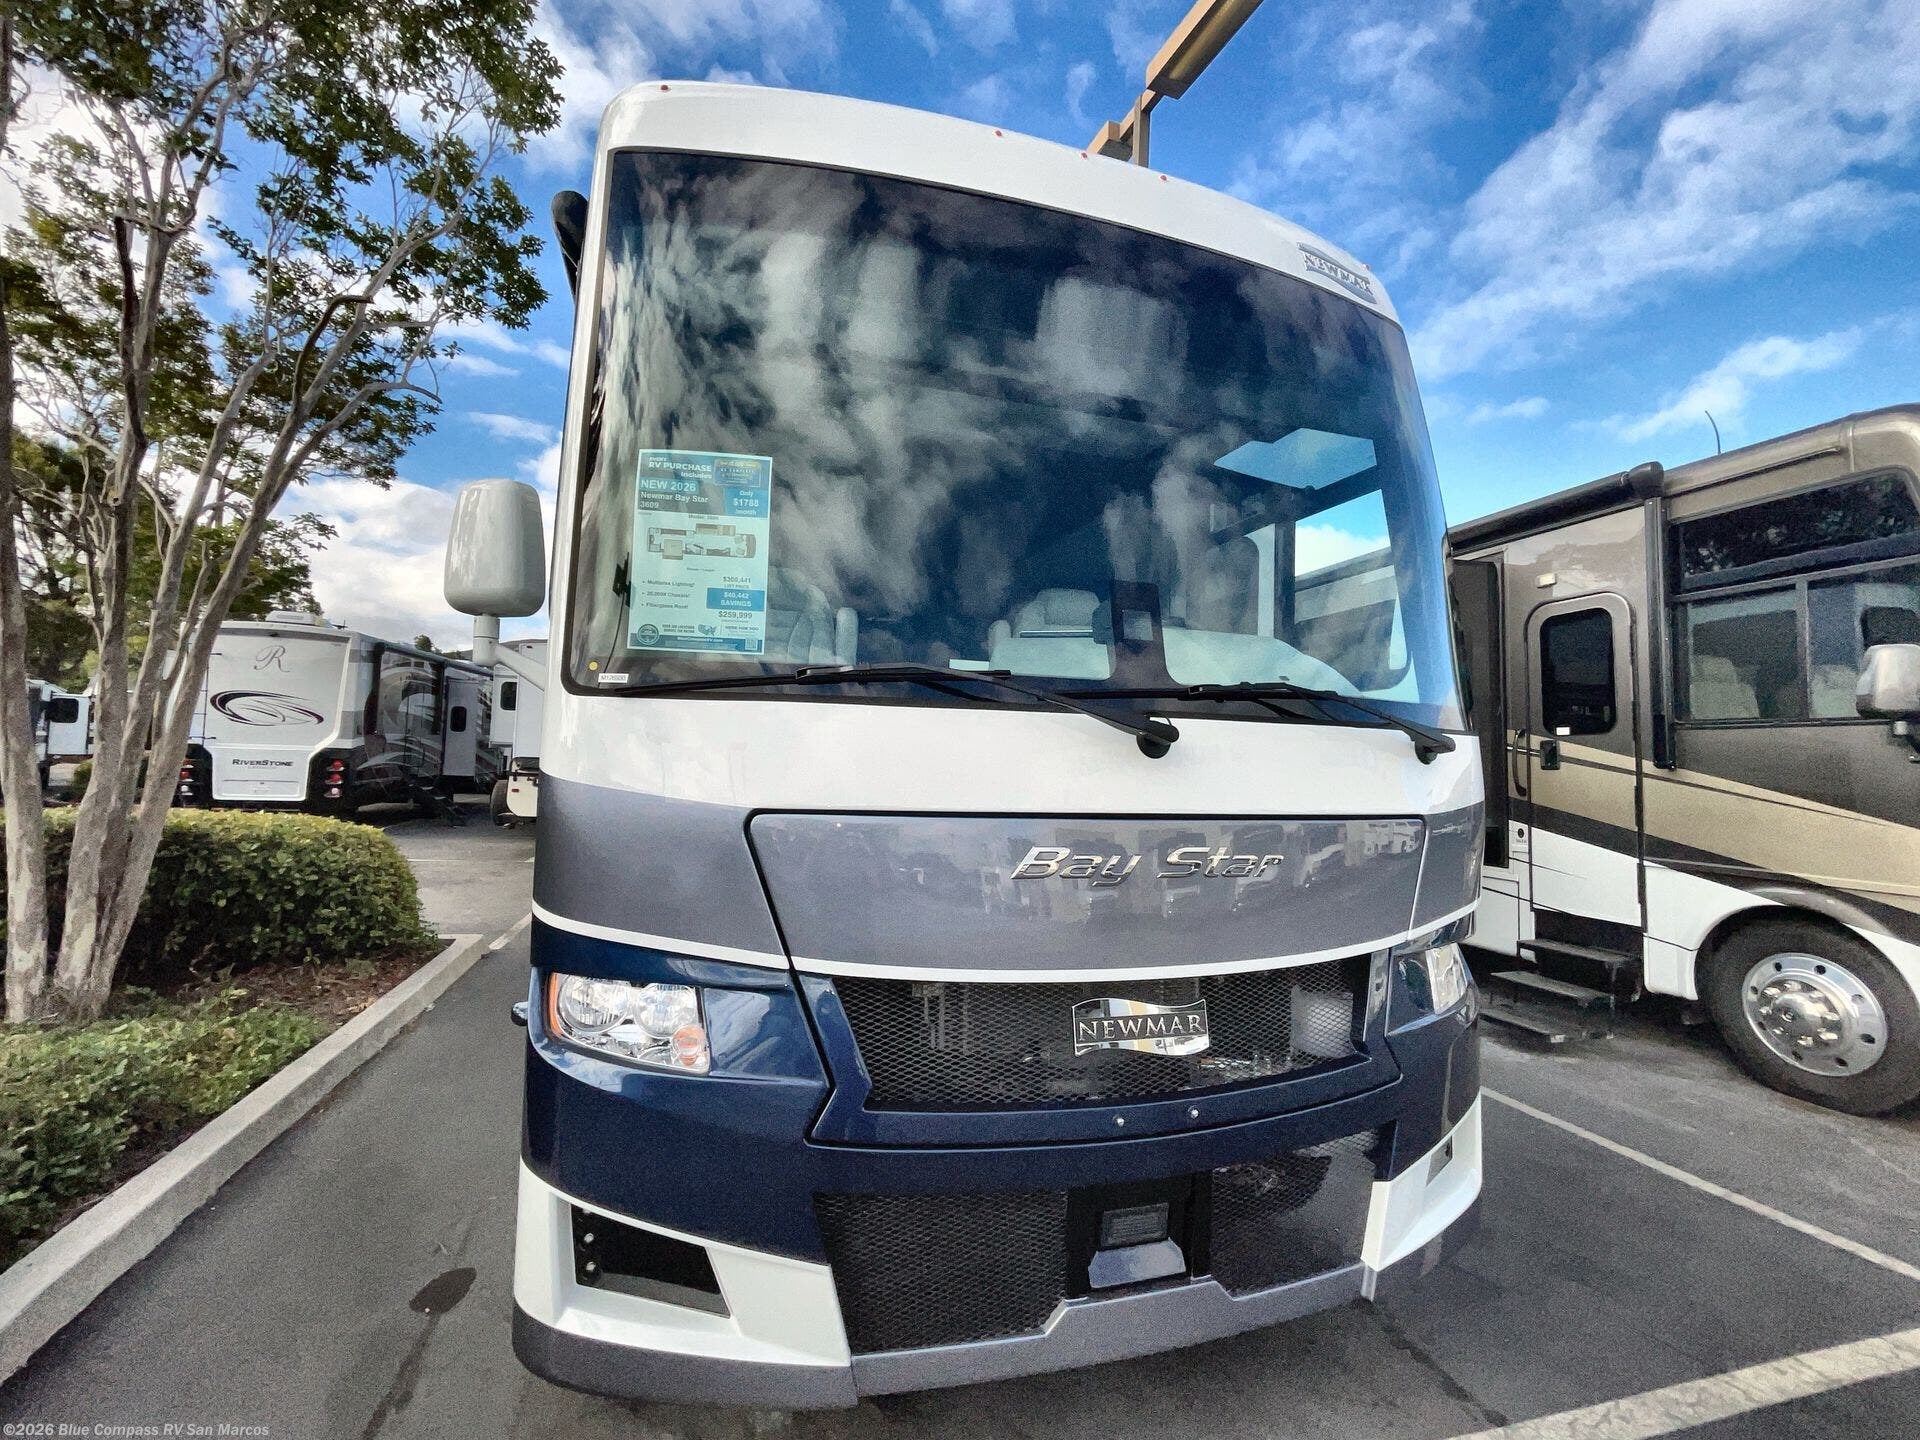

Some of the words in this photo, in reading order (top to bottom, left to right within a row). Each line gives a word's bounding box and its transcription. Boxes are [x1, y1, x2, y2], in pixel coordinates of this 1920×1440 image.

[648, 461, 662, 469] RV
[664, 462, 712, 472] PURCHASE
[640, 479, 667, 490] NEW
[670, 481, 697, 492] 2026
[640, 491, 673, 501] Newmar
[675, 493, 691, 503] Bay
[692, 495, 709, 503] Star
[739, 490, 754, 498] Only
[639, 500, 659, 509] 3609
[720, 599, 752, 607] SAVINGS
[718, 611, 753, 620] $259,999
[1010, 846, 1143, 887] Bay
[1156, 846, 1285, 879] Star
[1078, 1014, 1206, 1041] NEWMAR
